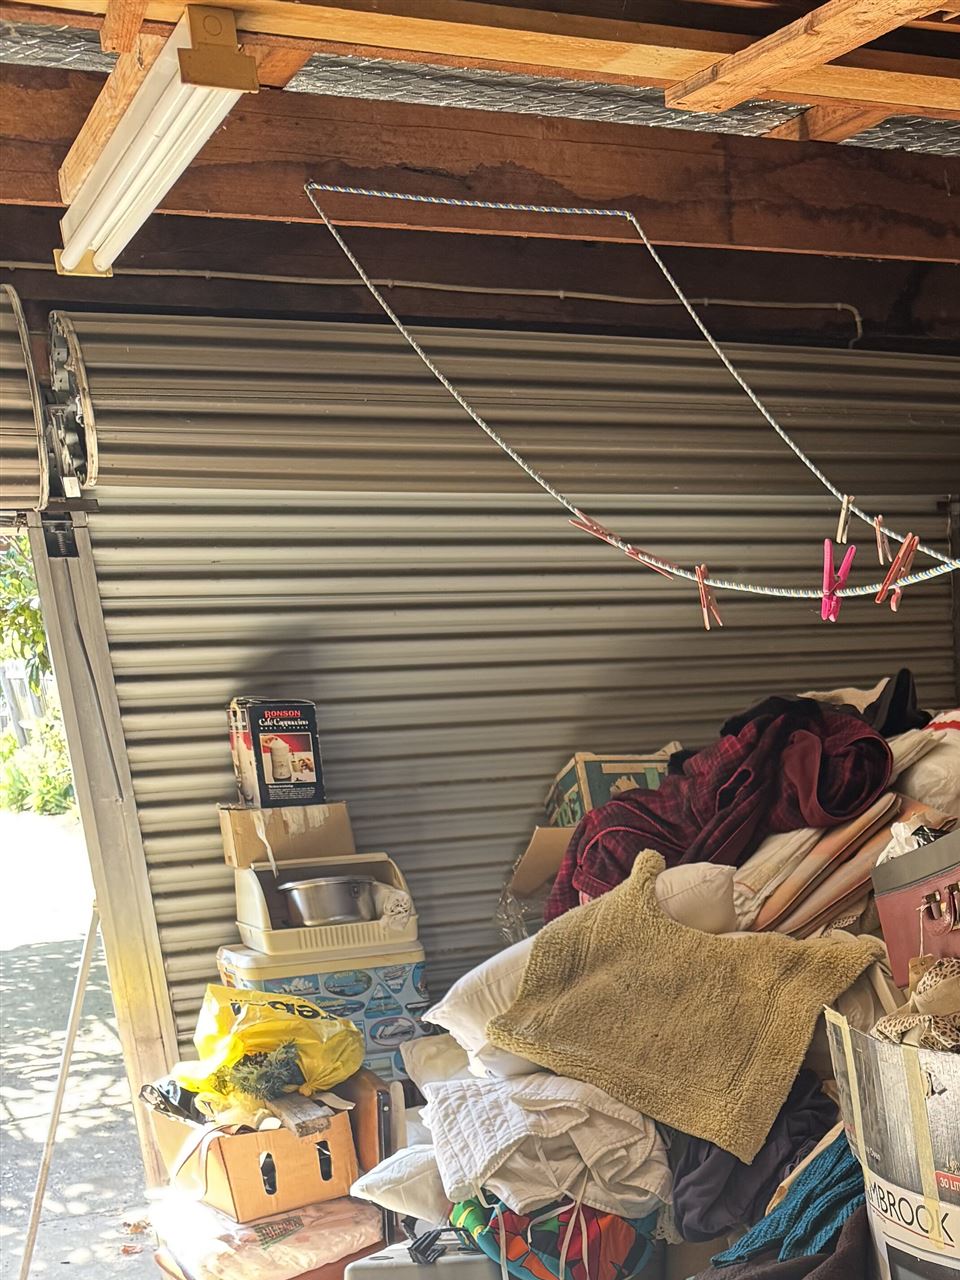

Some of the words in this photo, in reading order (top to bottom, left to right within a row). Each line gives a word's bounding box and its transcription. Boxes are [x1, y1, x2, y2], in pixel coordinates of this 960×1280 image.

[263, 710, 301, 719] RONSON
[938, 1177, 950, 1189] 30
[870, 1182, 954, 1242] MBROOK
